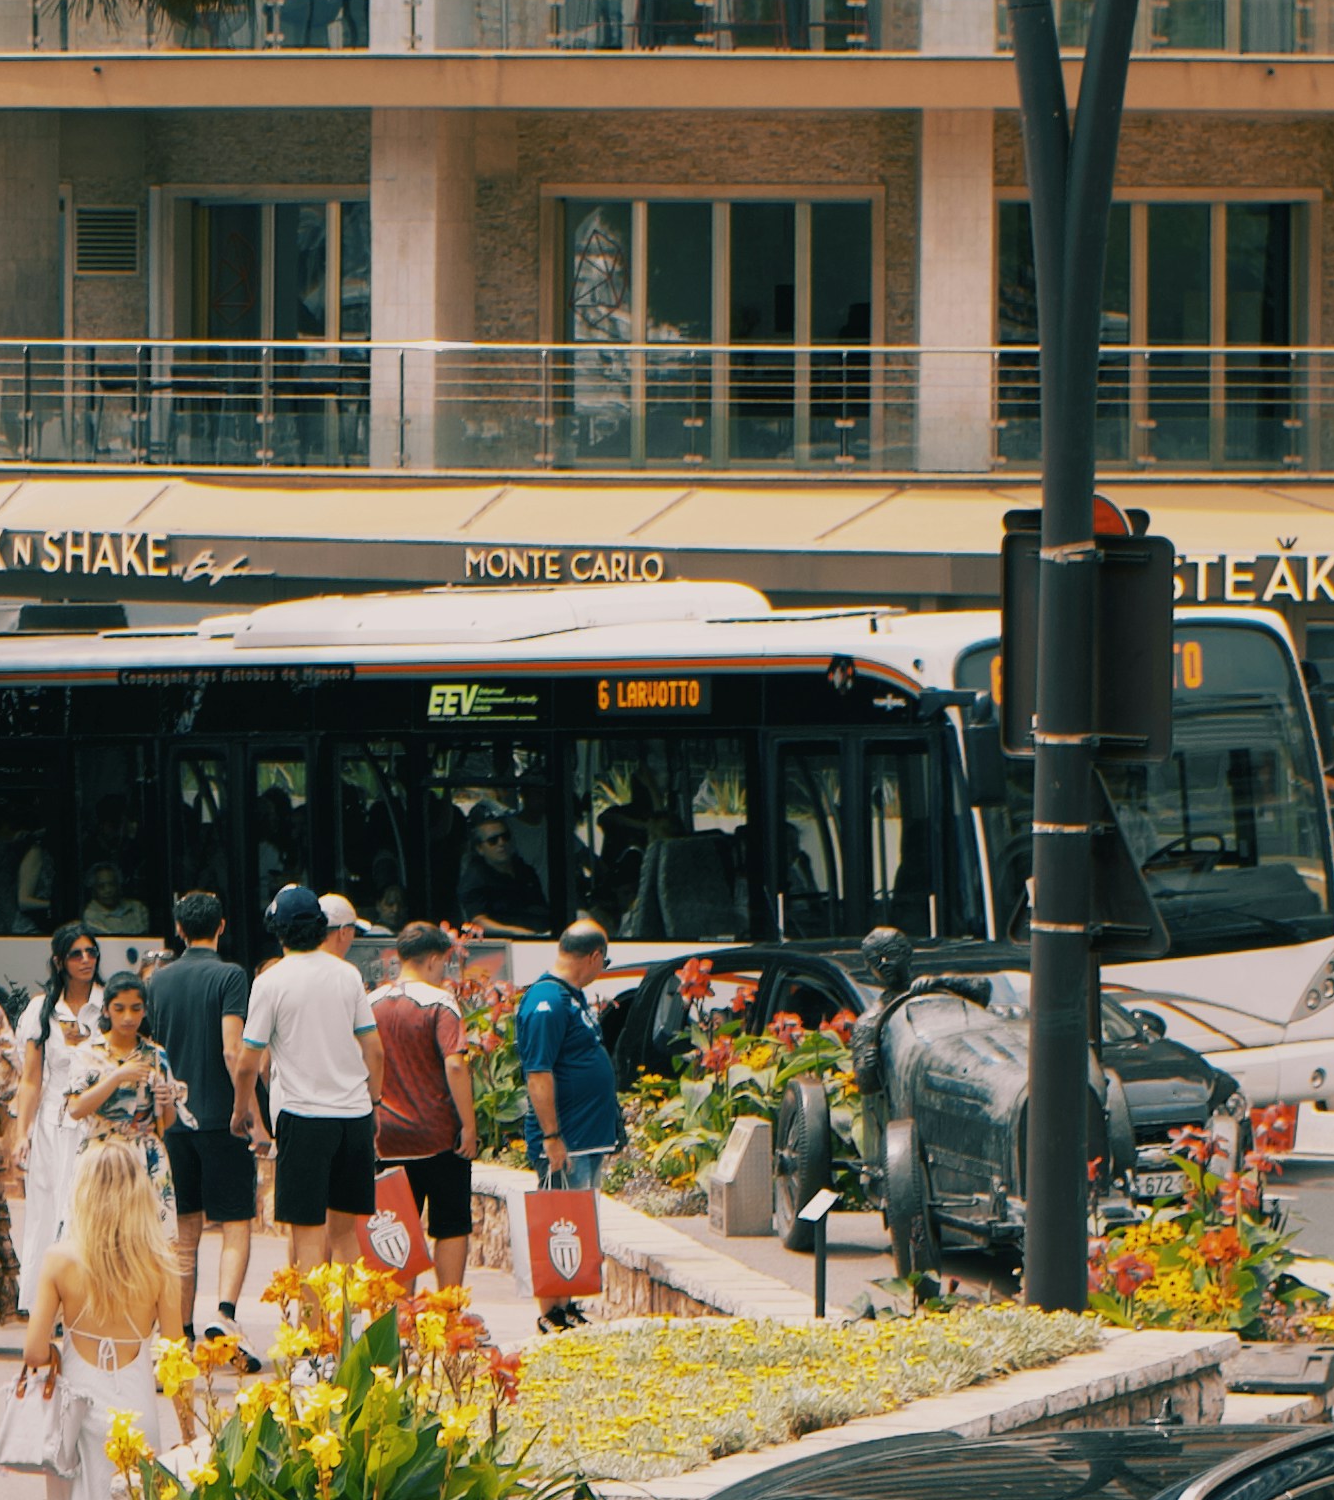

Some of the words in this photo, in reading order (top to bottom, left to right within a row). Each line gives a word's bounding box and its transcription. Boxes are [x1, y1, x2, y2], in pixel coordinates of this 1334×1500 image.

[13, 536, 32, 566] N
[41, 531, 169, 577] SHAKE
[465, 548, 561, 580] MONTE
[570, 551, 664, 583] CARLO
[427, 684, 479, 716] EEV
[597, 679, 610, 710] 6
[616, 679, 701, 708] LARVOTTO
